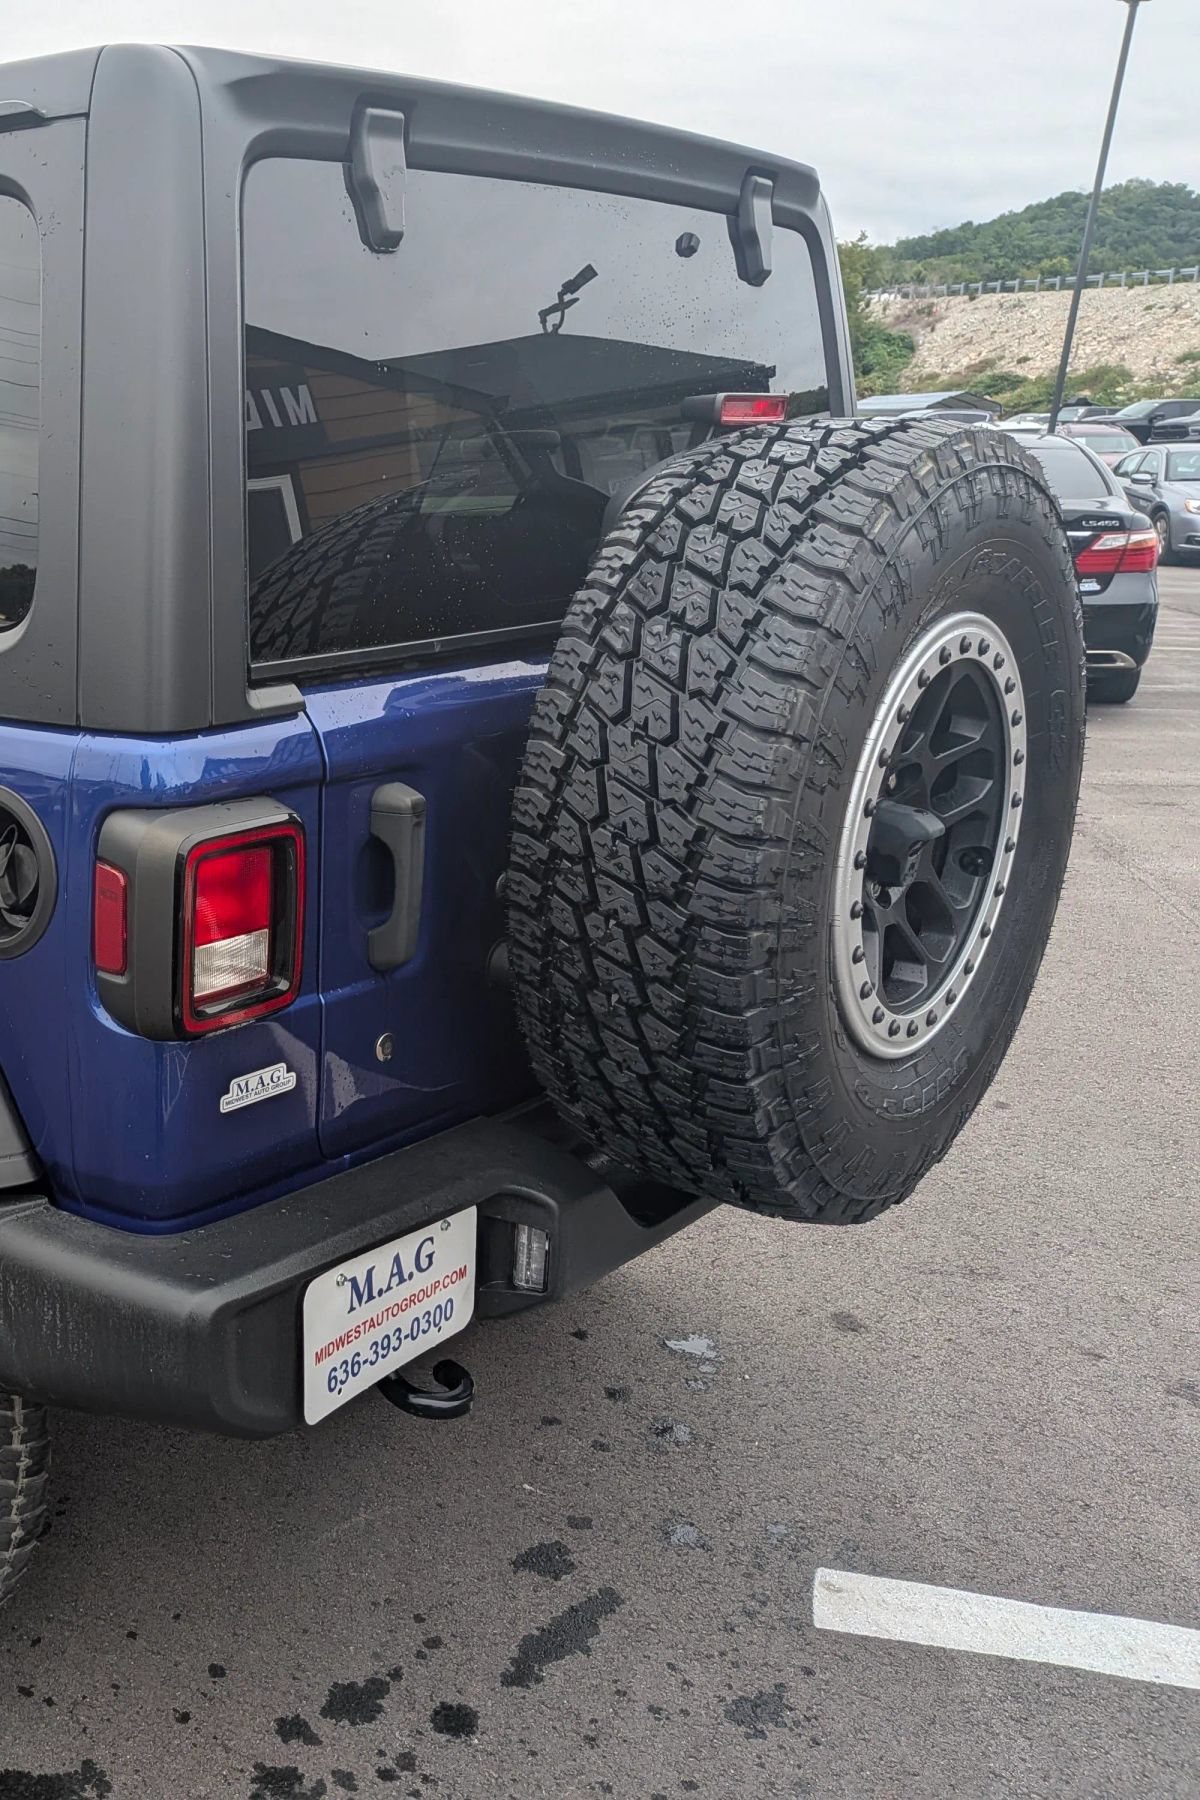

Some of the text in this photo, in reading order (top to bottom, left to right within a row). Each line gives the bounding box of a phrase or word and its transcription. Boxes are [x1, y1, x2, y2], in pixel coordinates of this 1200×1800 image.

[225, 1079, 292, 1106] MIDWEST AUTO GROUP
[314, 1264, 467, 1367] MIDWESTAUTOGROUP.COM
[347, 1236, 436, 1315] M.A.G
[327, 1297, 454, 1393] 636-393-0300
